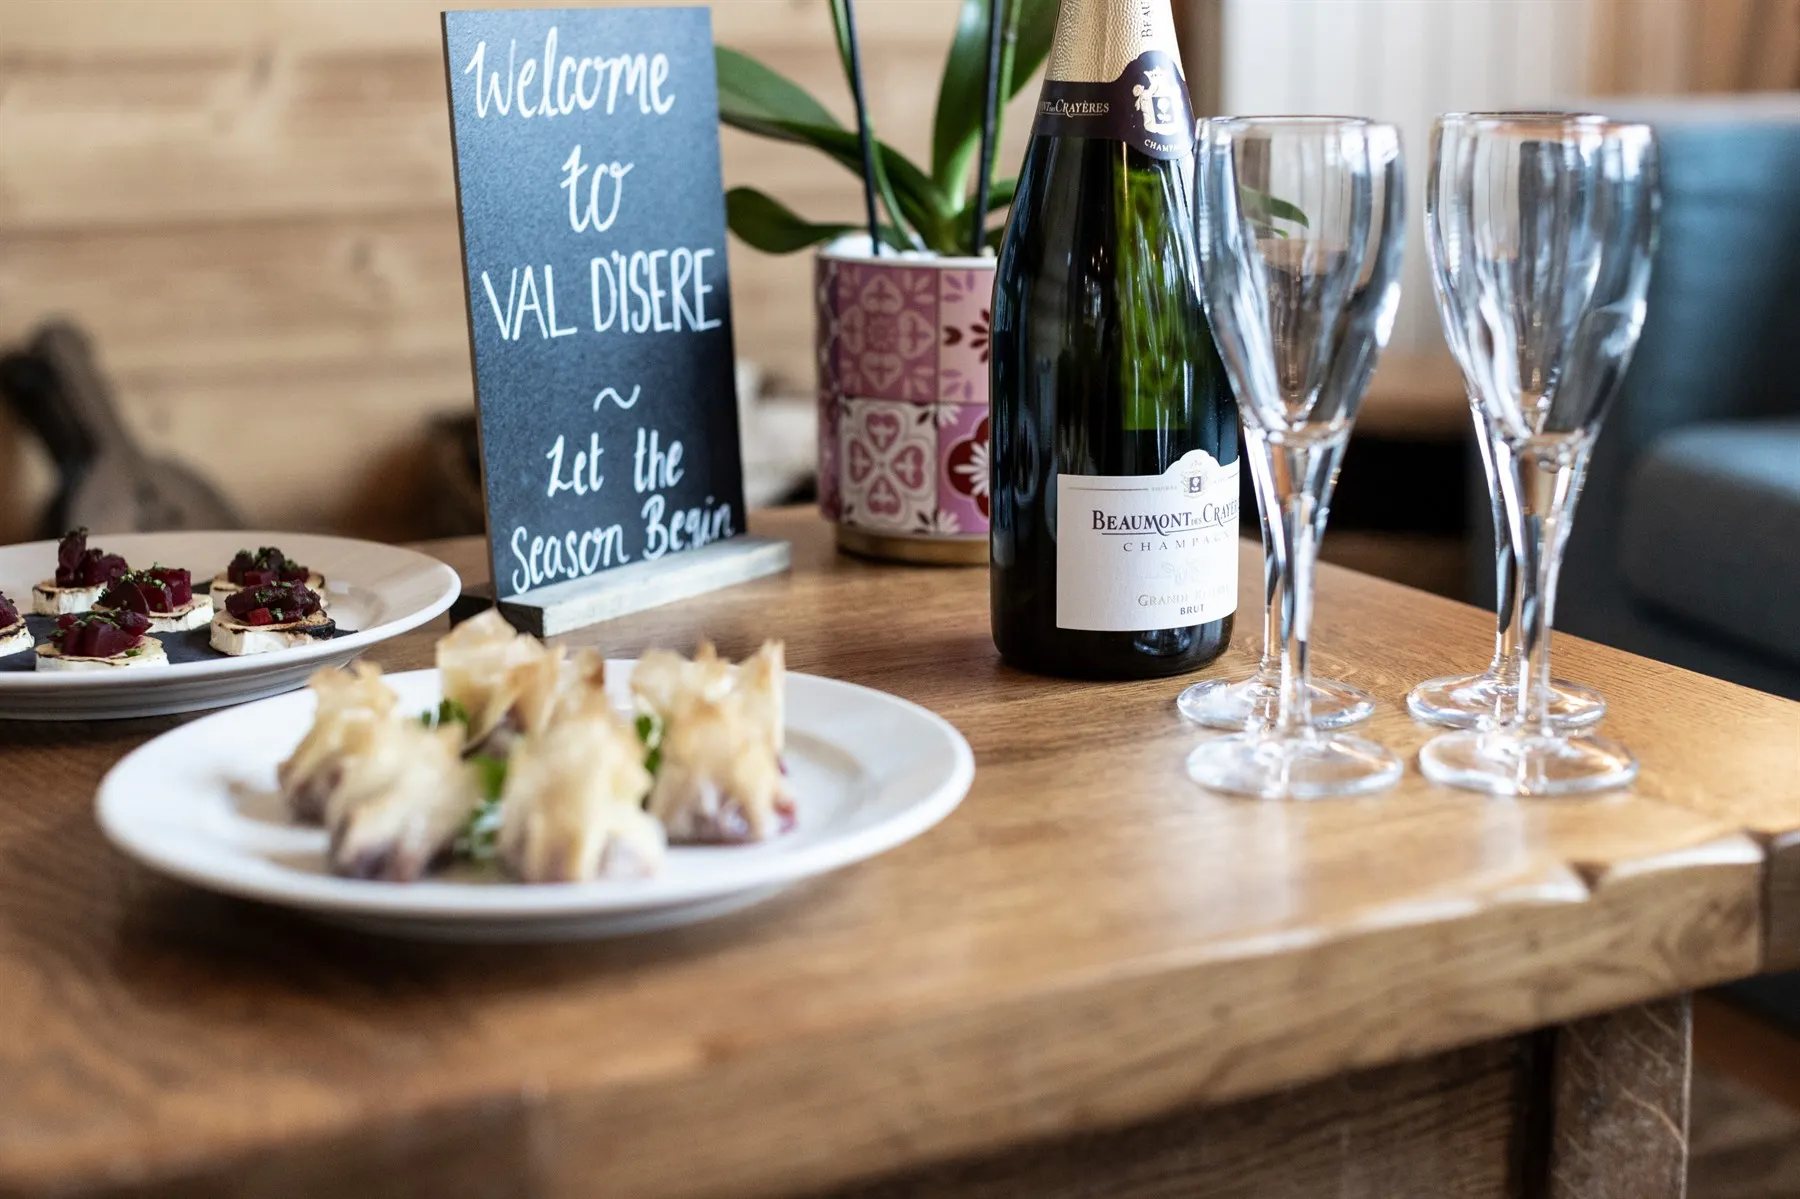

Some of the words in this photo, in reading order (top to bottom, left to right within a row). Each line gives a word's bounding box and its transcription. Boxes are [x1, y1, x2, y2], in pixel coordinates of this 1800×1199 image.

[465, 26, 675, 118] Welcome
[560, 144, 634, 233] to
[481, 264, 578, 341] VAL
[590, 247, 722, 333] D'ISERE
[546, 431, 605, 498] Let
[633, 427, 685, 494] the
[511, 524, 631, 595] Season
[641, 494, 735, 561] Begin
[1092, 509, 1193, 536] BEAUMONT
[1180, 604, 1204, 616] BRUT
